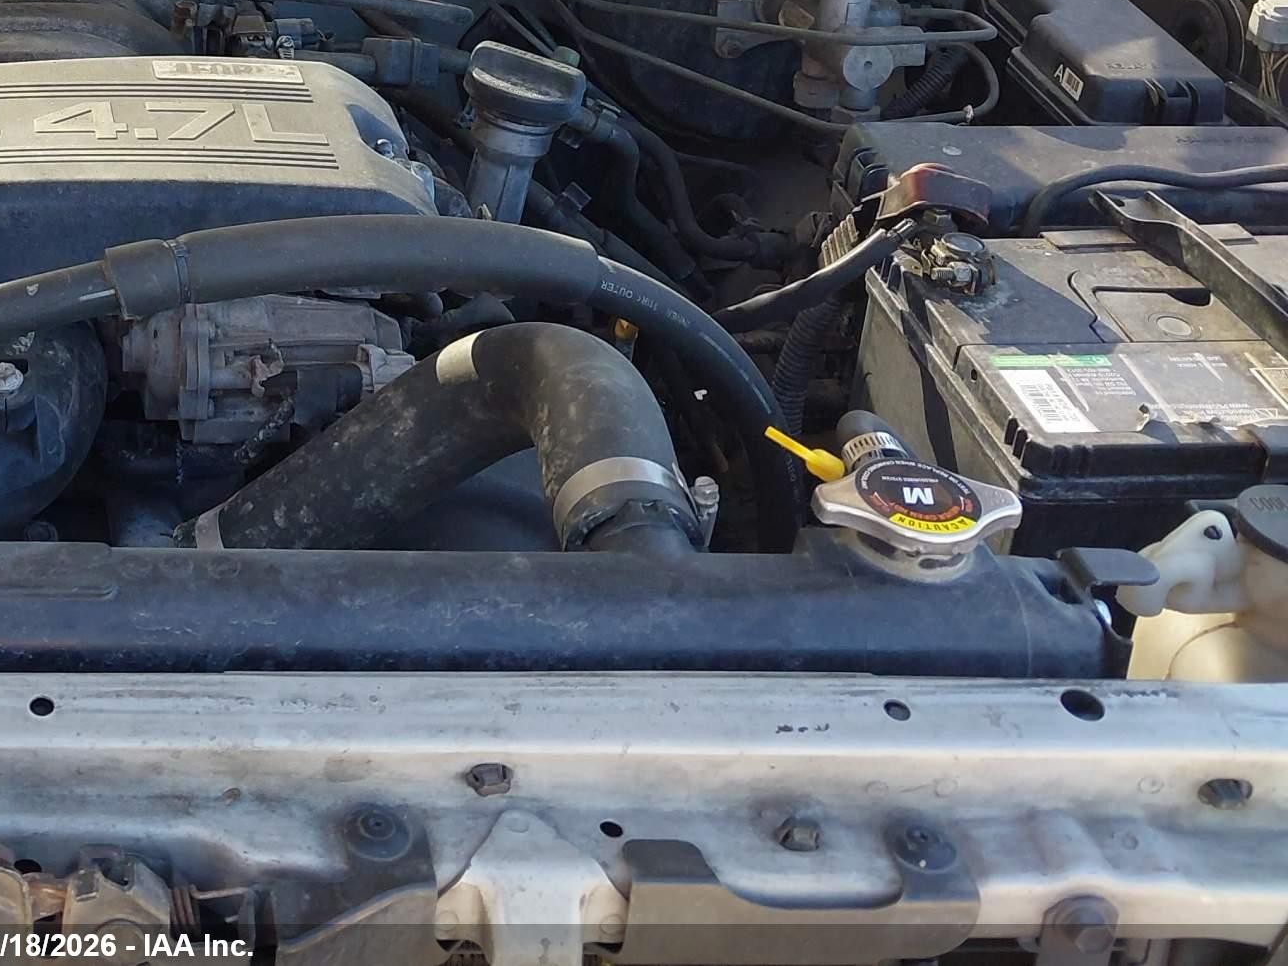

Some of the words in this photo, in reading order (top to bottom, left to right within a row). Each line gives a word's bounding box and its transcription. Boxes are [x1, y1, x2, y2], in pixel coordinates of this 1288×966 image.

[33, 101, 330, 147] 4.7L
[902, 486, 934, 505] M
[898, 516, 960, 531] CAUTION
